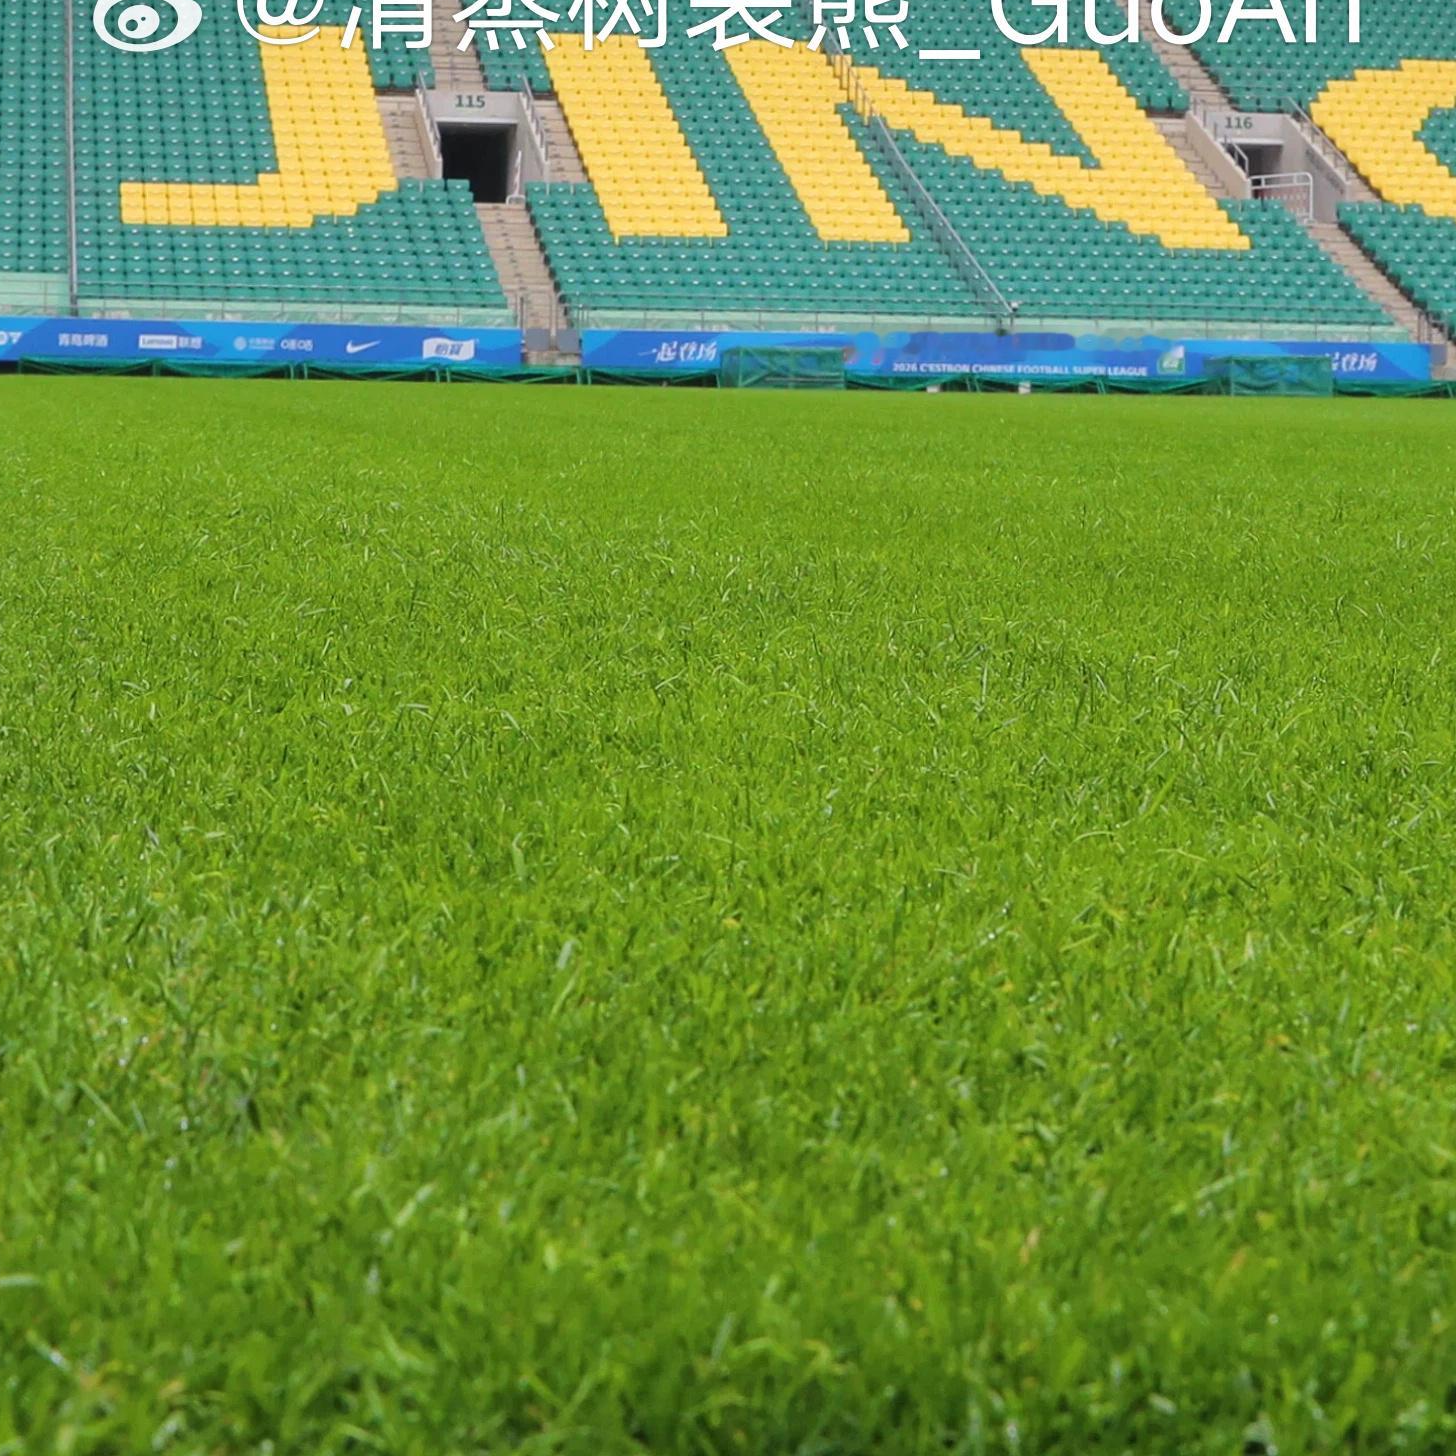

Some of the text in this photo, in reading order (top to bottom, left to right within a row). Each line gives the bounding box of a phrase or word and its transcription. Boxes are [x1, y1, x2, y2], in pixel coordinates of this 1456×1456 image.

[455, 94, 486, 108] 115
[1225, 116, 1254, 130] 116
[971, 364, 1016, 374] CHINESE
[1017, 364, 1069, 375] FOOTBALL
[1071, 365, 1107, 375] SUPER
[1107, 366, 1148, 376] LEAGUE
